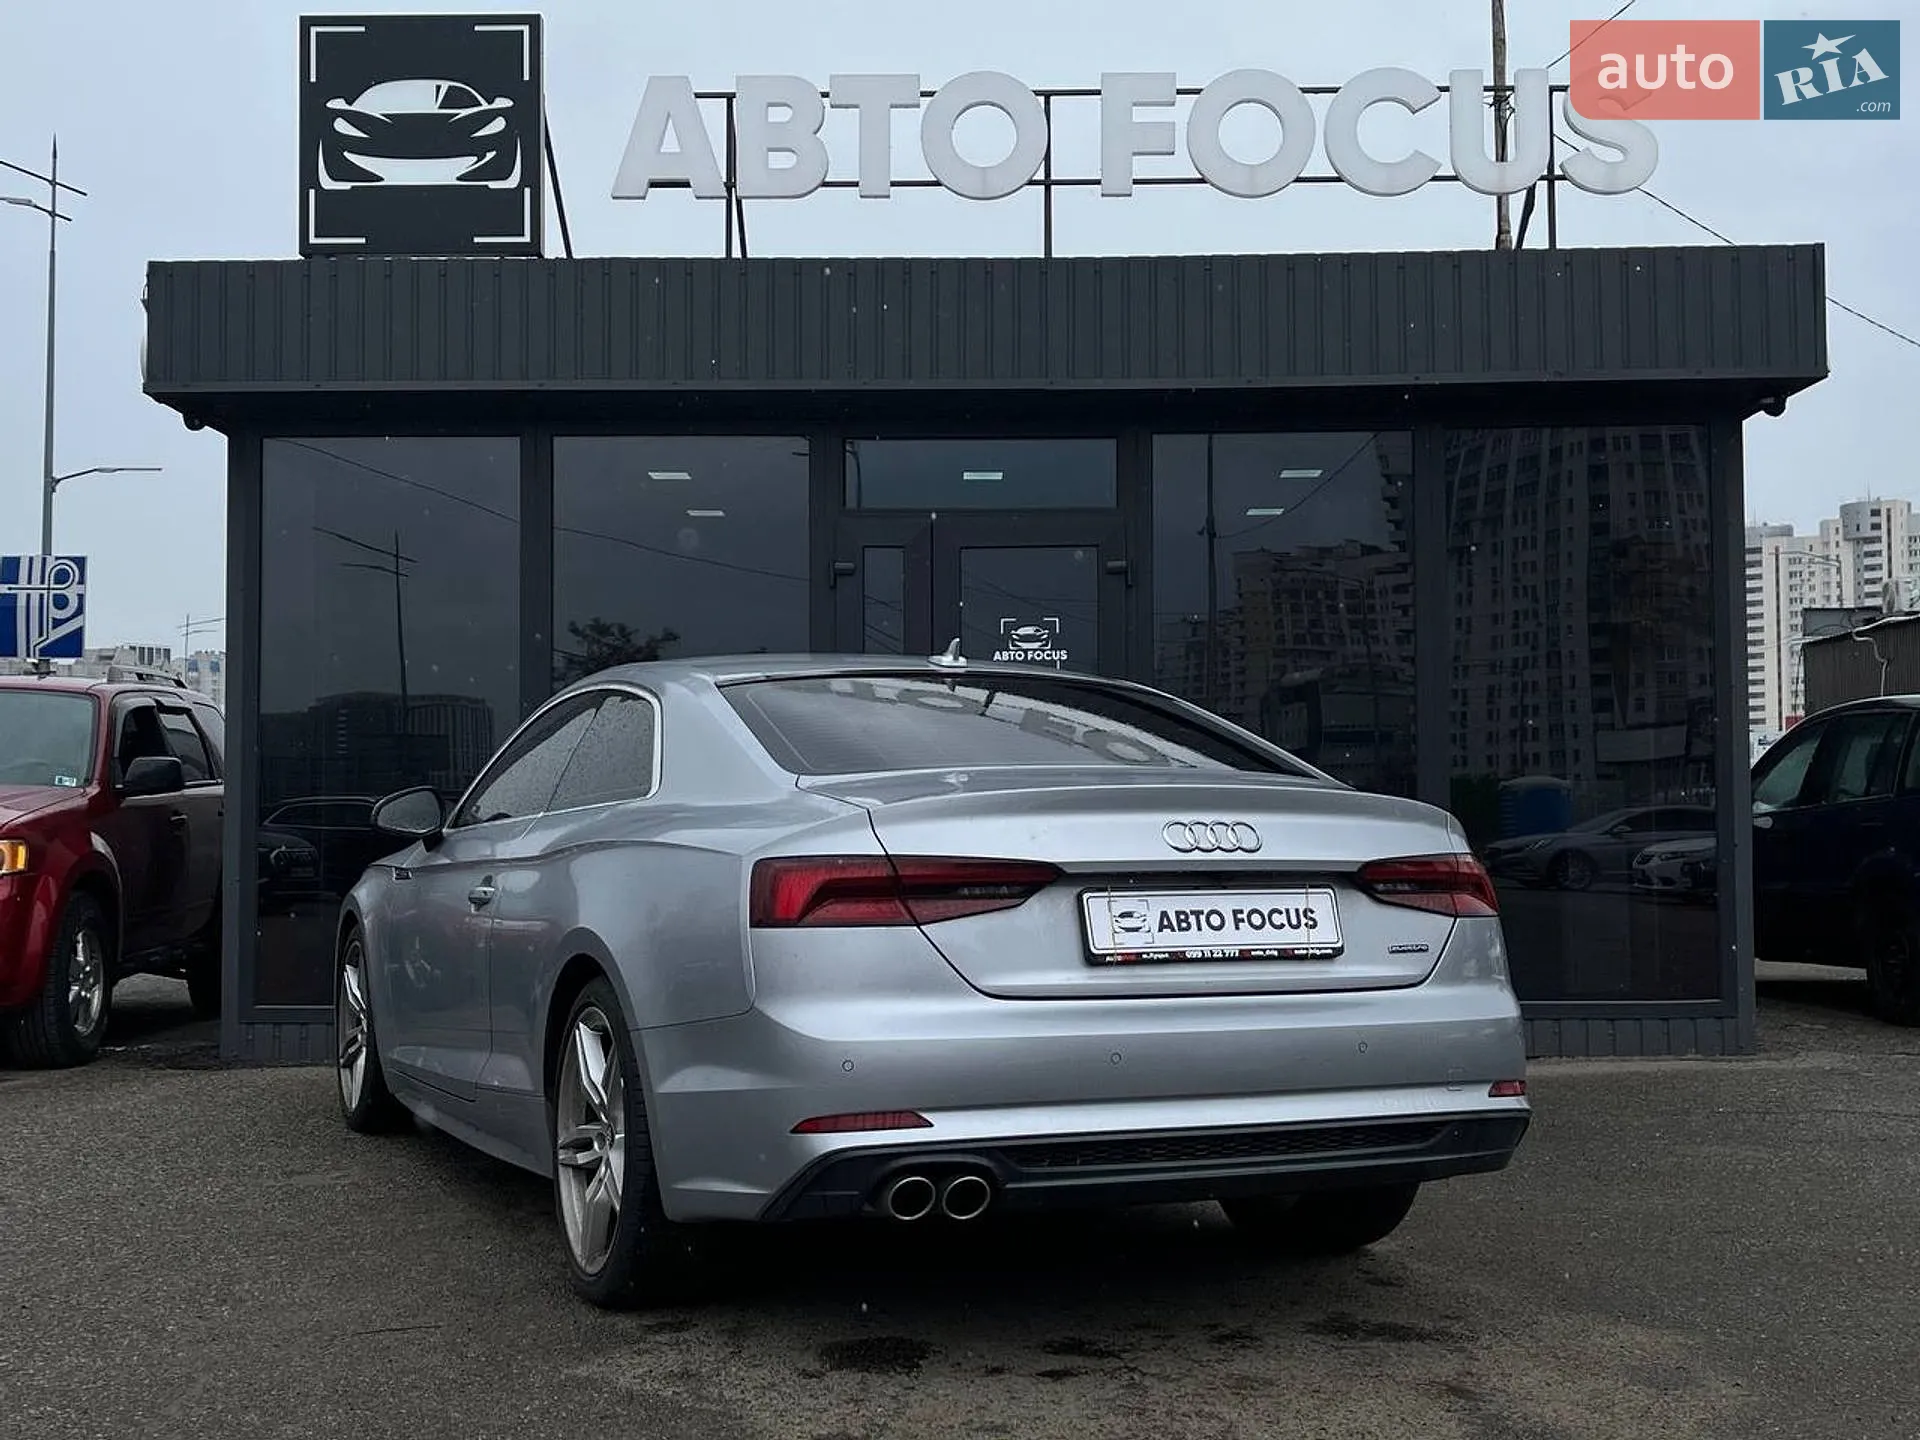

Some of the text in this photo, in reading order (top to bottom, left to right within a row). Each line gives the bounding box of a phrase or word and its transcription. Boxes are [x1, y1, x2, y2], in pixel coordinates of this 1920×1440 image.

[611, 67, 1659, 200] АВТО FOCUS
[993, 649, 1068, 661] АВТО FOCUS
[1157, 907, 1319, 933] АВТО FOCUS
